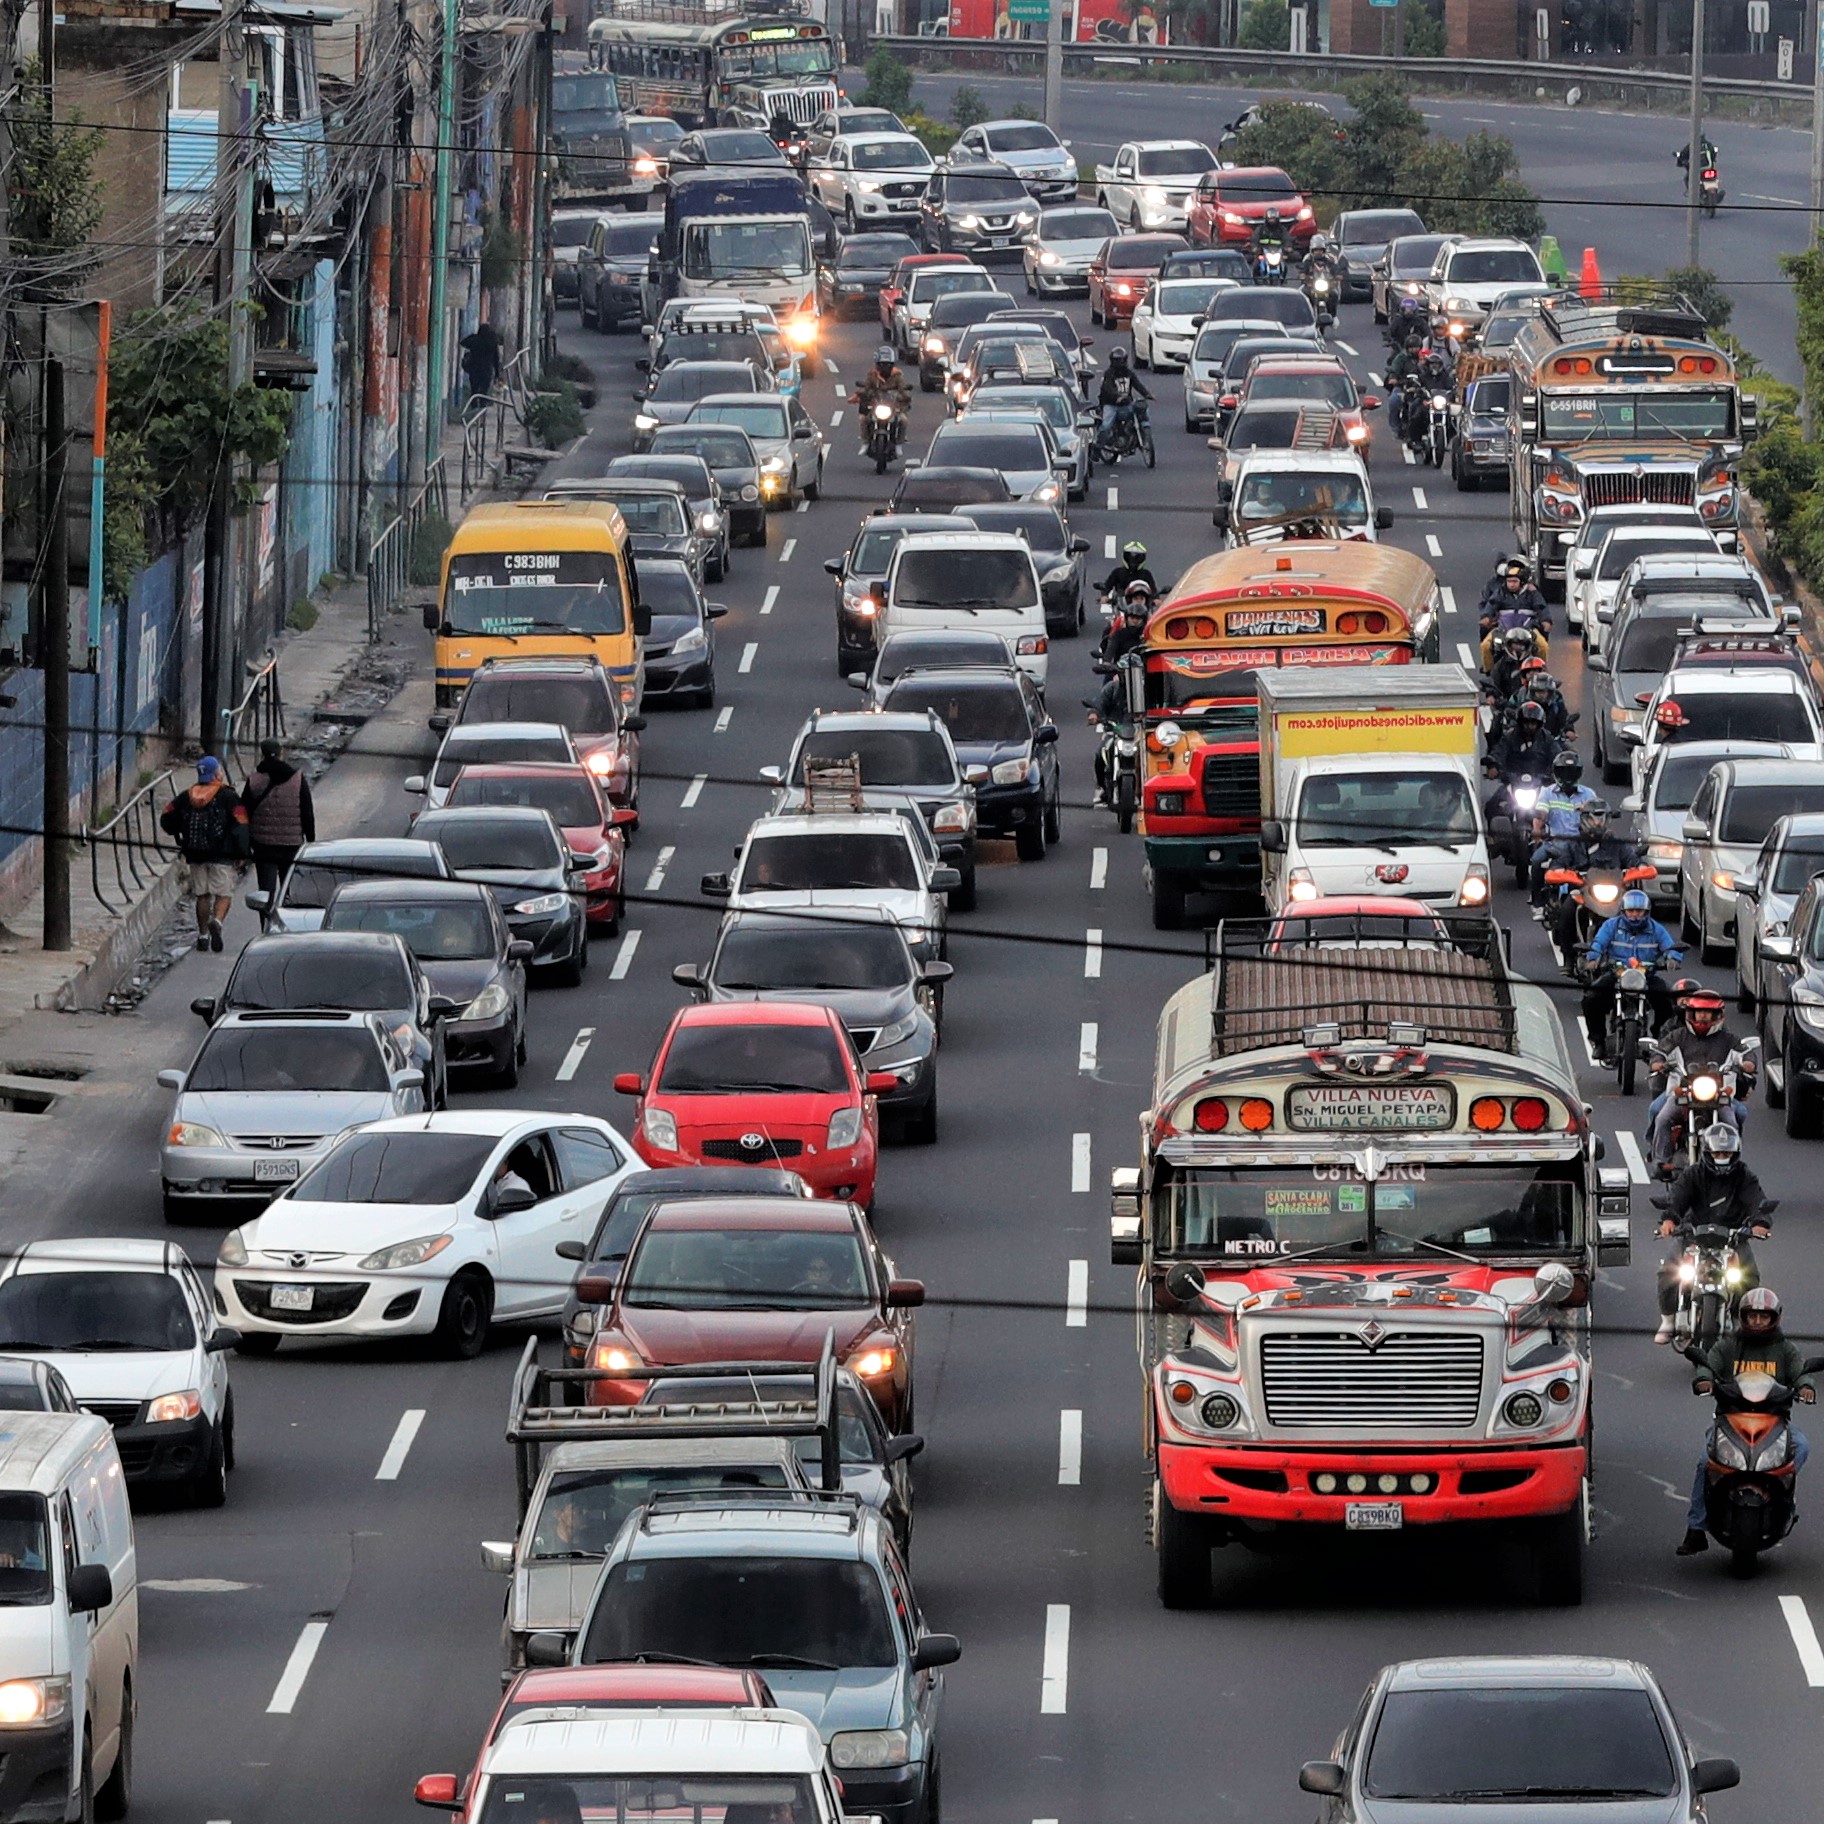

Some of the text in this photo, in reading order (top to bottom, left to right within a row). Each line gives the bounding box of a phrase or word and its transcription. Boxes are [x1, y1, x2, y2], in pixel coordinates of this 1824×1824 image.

[1307, 1089, 1436, 1102] VILLA NUEVA
[1320, 1105, 1376, 1115] MIGUEL
[1381, 1104, 1447, 1114] PETAPA
[1303, 1116, 1438, 1127] VILLA CANALES
[1268, 1191, 1330, 1202] SANTA CLARA
